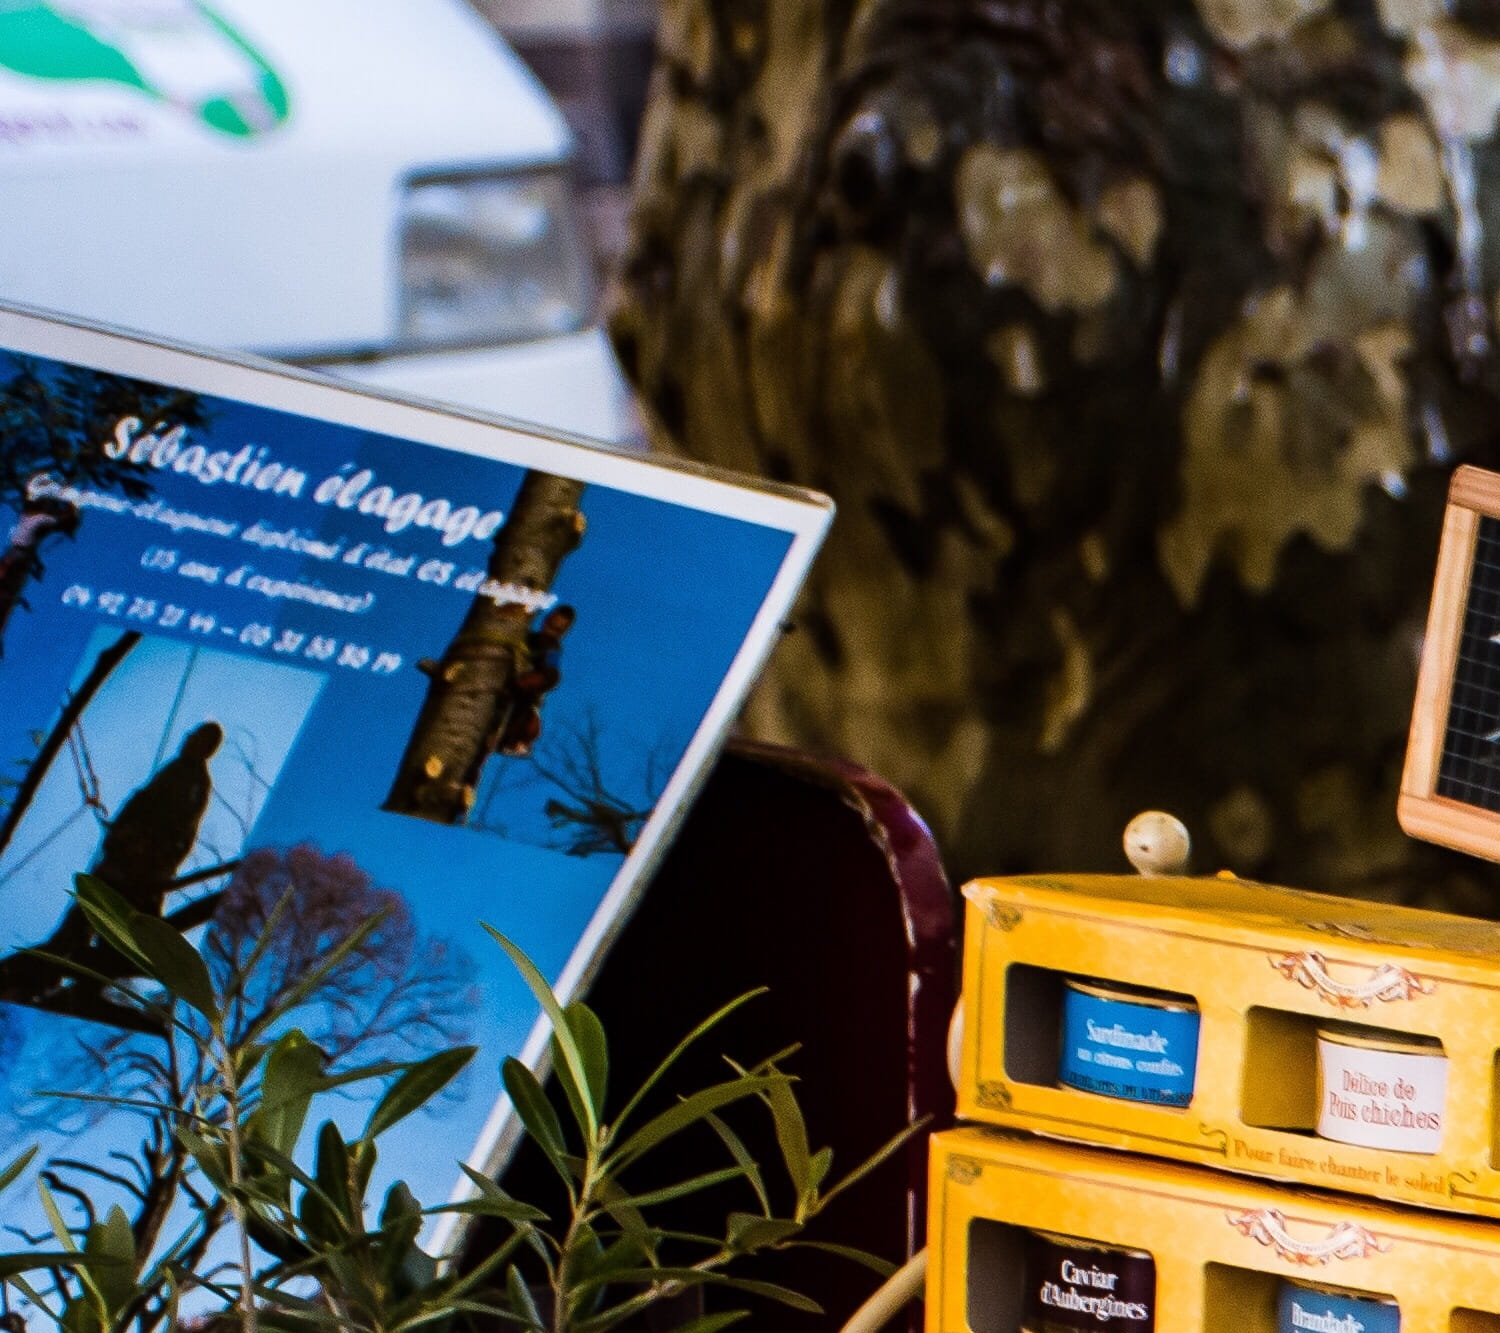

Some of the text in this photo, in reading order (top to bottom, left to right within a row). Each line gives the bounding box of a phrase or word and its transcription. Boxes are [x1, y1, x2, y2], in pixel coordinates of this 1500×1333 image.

[104, 416, 306, 498] Sébastien
[314, 462, 503, 546] élagage
[1362, 1098, 1440, 1130] chiches
[1061, 1260, 1118, 1290] Caviar
[1040, 1282, 1148, 1321] d'Aubergines
